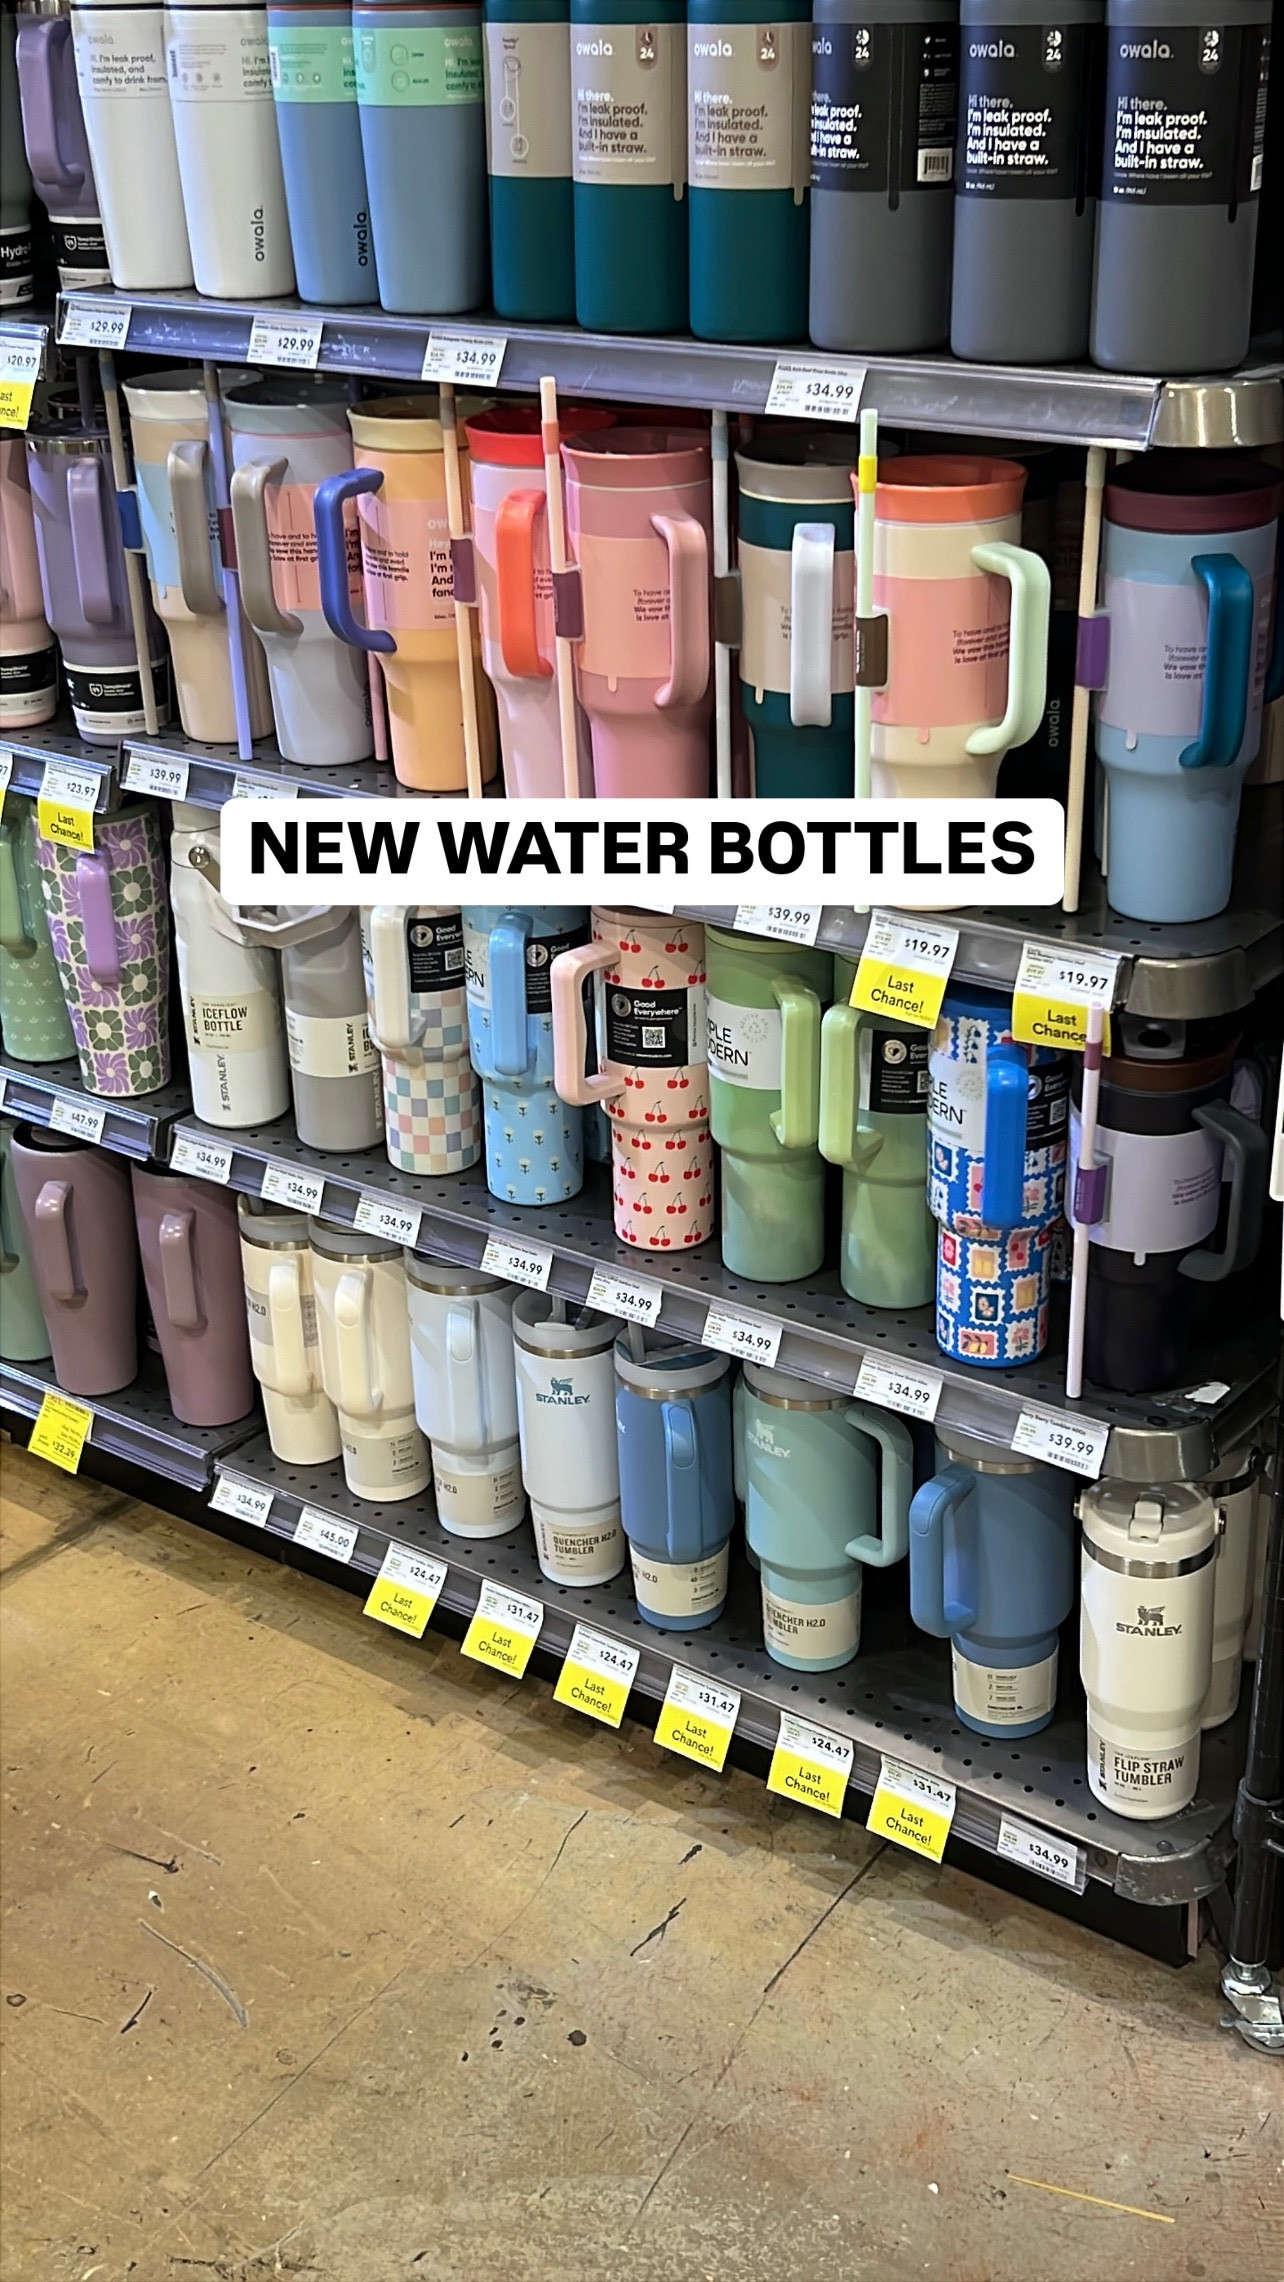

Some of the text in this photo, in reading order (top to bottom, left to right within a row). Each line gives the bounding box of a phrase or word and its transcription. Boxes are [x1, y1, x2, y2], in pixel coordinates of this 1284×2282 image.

[576, 39, 614, 56] owala
[639, 47, 655, 60] 24
[694, 39, 733, 57] owala
[760, 47, 776, 61] 24
[855, 46, 870, 60] 24
[1045, 47, 1062, 61] 24
[1202, 48, 1220, 62] 24
[111, 53, 130, 63] leak
[128, 65, 145, 74] and
[114, 75, 146, 85] to drink
[586, 88, 614, 102] there.
[703, 90, 733, 105] there.
[967, 94, 977, 107] Hi
[1117, 96, 1128, 110] Hi
[590, 102, 648, 118] leak proof.
[707, 104, 768, 119] leak proof.
[830, 103, 862, 119] proof.
[967, 108, 1052, 126] I'm leak proof.
[590, 115, 643, 127] insulated.
[707, 118, 764, 131] insulated.
[1116, 110, 1208, 129] I'm leak proof.
[600, 128, 627, 140] have
[629, 131, 639, 141] a
[717, 131, 746, 144] have
[749, 133, 758, 144] a
[966, 122, 1046, 137] I'm insulated.
[1115, 124, 1202, 141] I'm insulated.
[611, 142, 647, 154] straw.
[843, 136, 852, 146] a
[966, 136, 1040, 151] And have a
[1114, 139, 1195, 155] And have a
[729, 145, 767, 158] straw.
[827, 145, 860, 160] straw.
[966, 151, 1049, 166] built-in straw.
[1114, 155, 1205, 170] built-in straw.
[250, 205, 265, 262] owala
[353, 210, 369, 267] owala
[90, 320, 124, 335] $29.99
[278, 336, 314, 352] $29.99
[7, 354, 37, 369] $20.97
[456, 350, 497, 366] $34.99
[806, 382, 854, 400] $34.99
[429, 550, 447, 562] I'm
[430, 564, 448, 574] I'm
[431, 575, 454, 586] And
[953, 629, 962, 639] To
[1164, 644, 1174, 654] To
[1047, 698, 1062, 748] owala
[150, 767, 182, 784] $39.99
[66, 781, 96, 798] $23.97
[57, 811, 75, 827] Last
[50, 822, 84, 842] Chance!
[768, 906, 812, 926] $39.99
[904, 937, 951, 960] $19.97
[887, 974, 915, 994] Last
[1059, 969, 1110, 991] $19.97
[633, 999, 656, 1009] Good
[871, 987, 925, 1014] Chance!
[202, 1006, 249, 1020] ICEFLOW
[1046, 1008, 1078, 1027] Last
[203, 1019, 244, 1032] BOTTLE
[1032, 1021, 1088, 1043] Chance
[345, 1022, 357, 1062] STANLEY
[216, 1054, 230, 1102] STANLEY
[71, 1111, 99, 1130] $47.99
[197, 1151, 227, 1169] $34.99
[287, 1181, 318, 1200] $34.99
[379, 1213, 413, 1233] $34.99
[508, 1255, 543, 1276] $34.99
[615, 1290, 653, 1311] $34.99
[732, 1329, 772, 1352] $34.99
[535, 1392, 591, 1406] STANLEY
[888, 1381, 931, 1404] $34.99
[1048, 1432, 1094, 1456] $39.99
[237, 1493, 267, 1513] $34.99
[320, 1528, 350, 1549] $45.00
[553, 1534, 600, 1549] QUENCHER
[554, 1544, 595, 1556] TUMBLER
[409, 1565, 442, 1586] $24.47
[393, 1592, 413, 1610] Last
[380, 1600, 418, 1626] Chance!
[507, 1603, 540, 1624] $31.47
[805, 1617, 826, 1629] H2.0
[1116, 1621, 1183, 1637] STANLEY
[491, 1631, 513, 1649] Last
[478, 1640, 518, 1665] Chance!
[599, 1650, 634, 1672] $24.47
[584, 1677, 606, 1697] Last
[570, 1686, 613, 1714] Chance!
[698, 1691, 736, 1714] $31.47
[685, 1720, 708, 1739] Last
[671, 1728, 715, 1757] Chance!
[811, 1736, 851, 1759] $24.47
[1113, 1755, 1185, 1774] FLIP STRAW
[798, 1766, 823, 1786] Last
[1114, 1768, 1173, 1786] TUMBLER
[784, 1775, 831, 1801] Chance!
[913, 1778, 952, 1803] $31.47
[900, 1807, 926, 1828] Last
[885, 1816, 933, 1847] Chance!
[1029, 1842, 1070, 1869] $34.99
